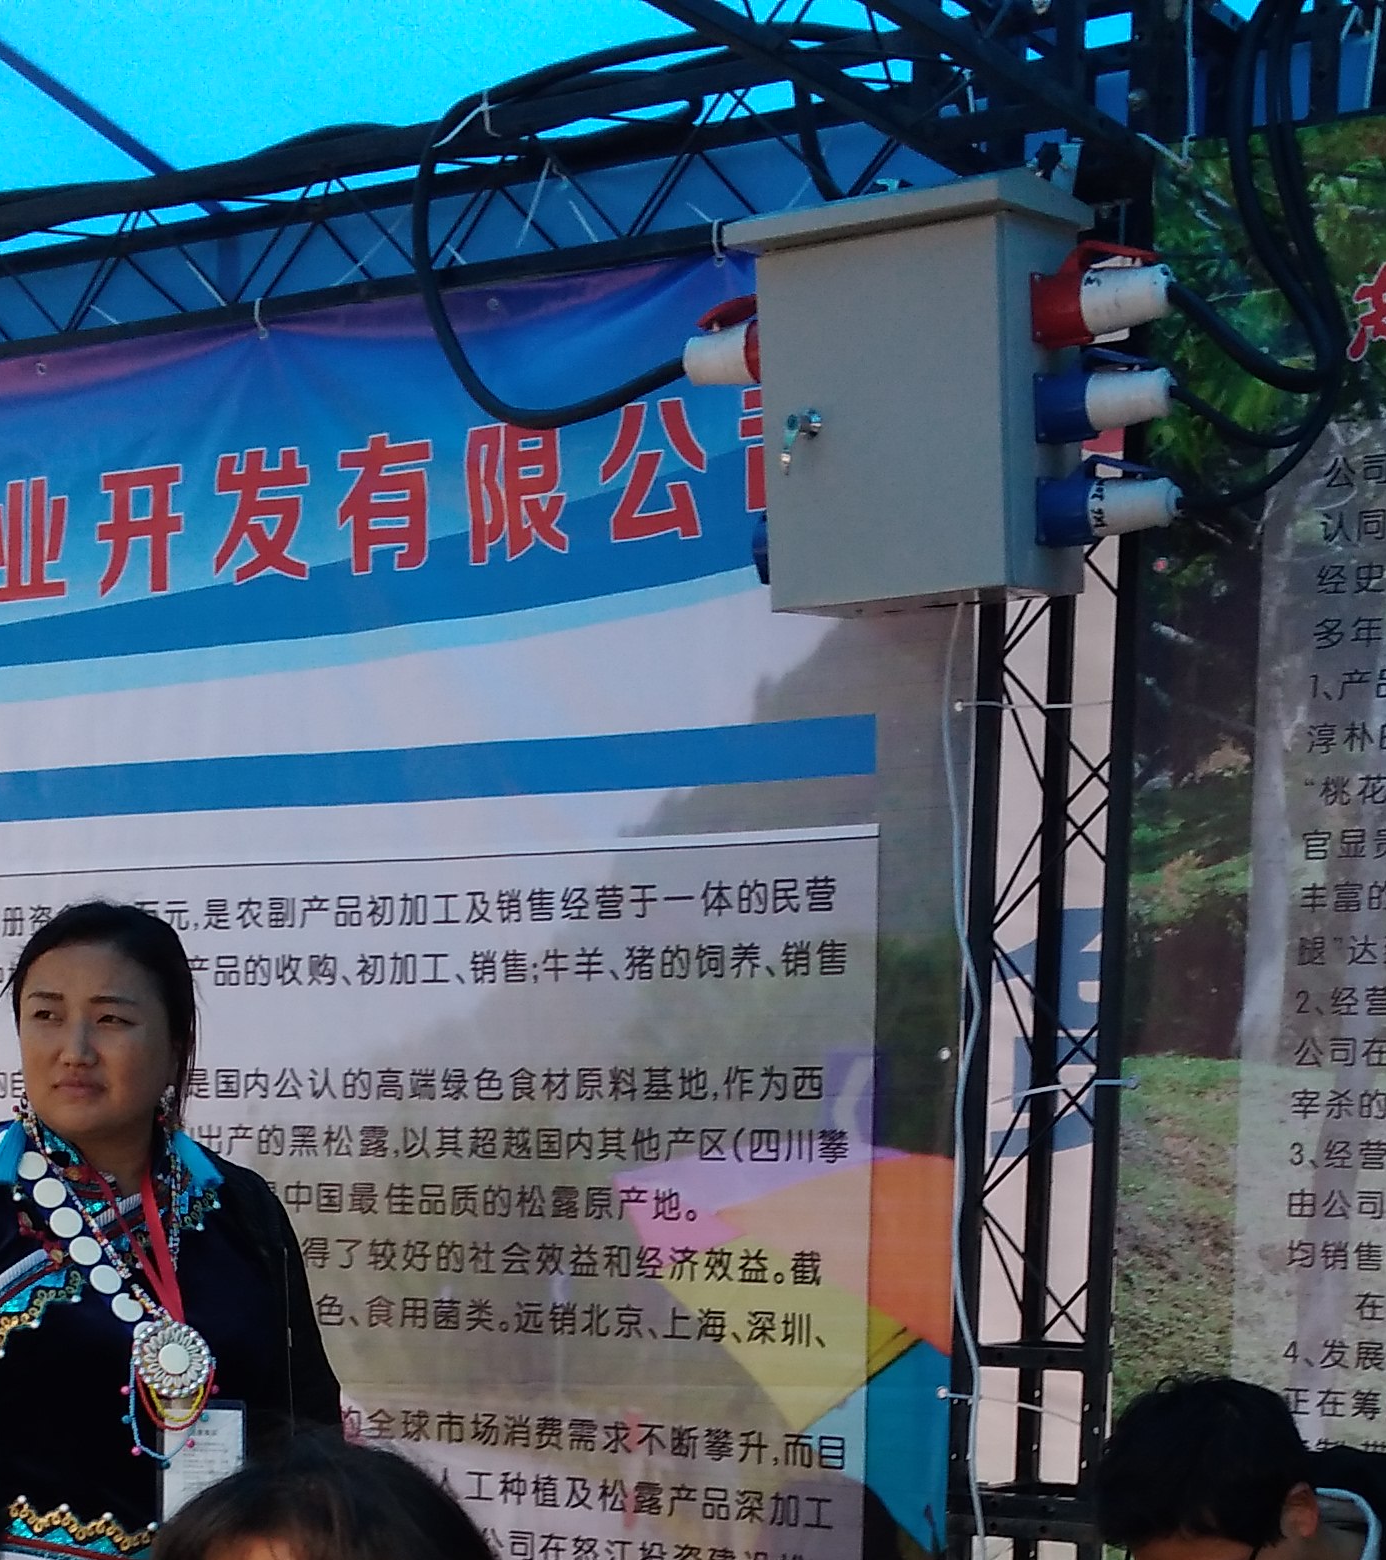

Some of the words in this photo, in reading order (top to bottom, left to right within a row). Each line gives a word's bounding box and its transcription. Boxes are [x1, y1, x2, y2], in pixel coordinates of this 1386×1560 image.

[271, 1180, 700, 1222] 中国最佳品质的松露原产地。
